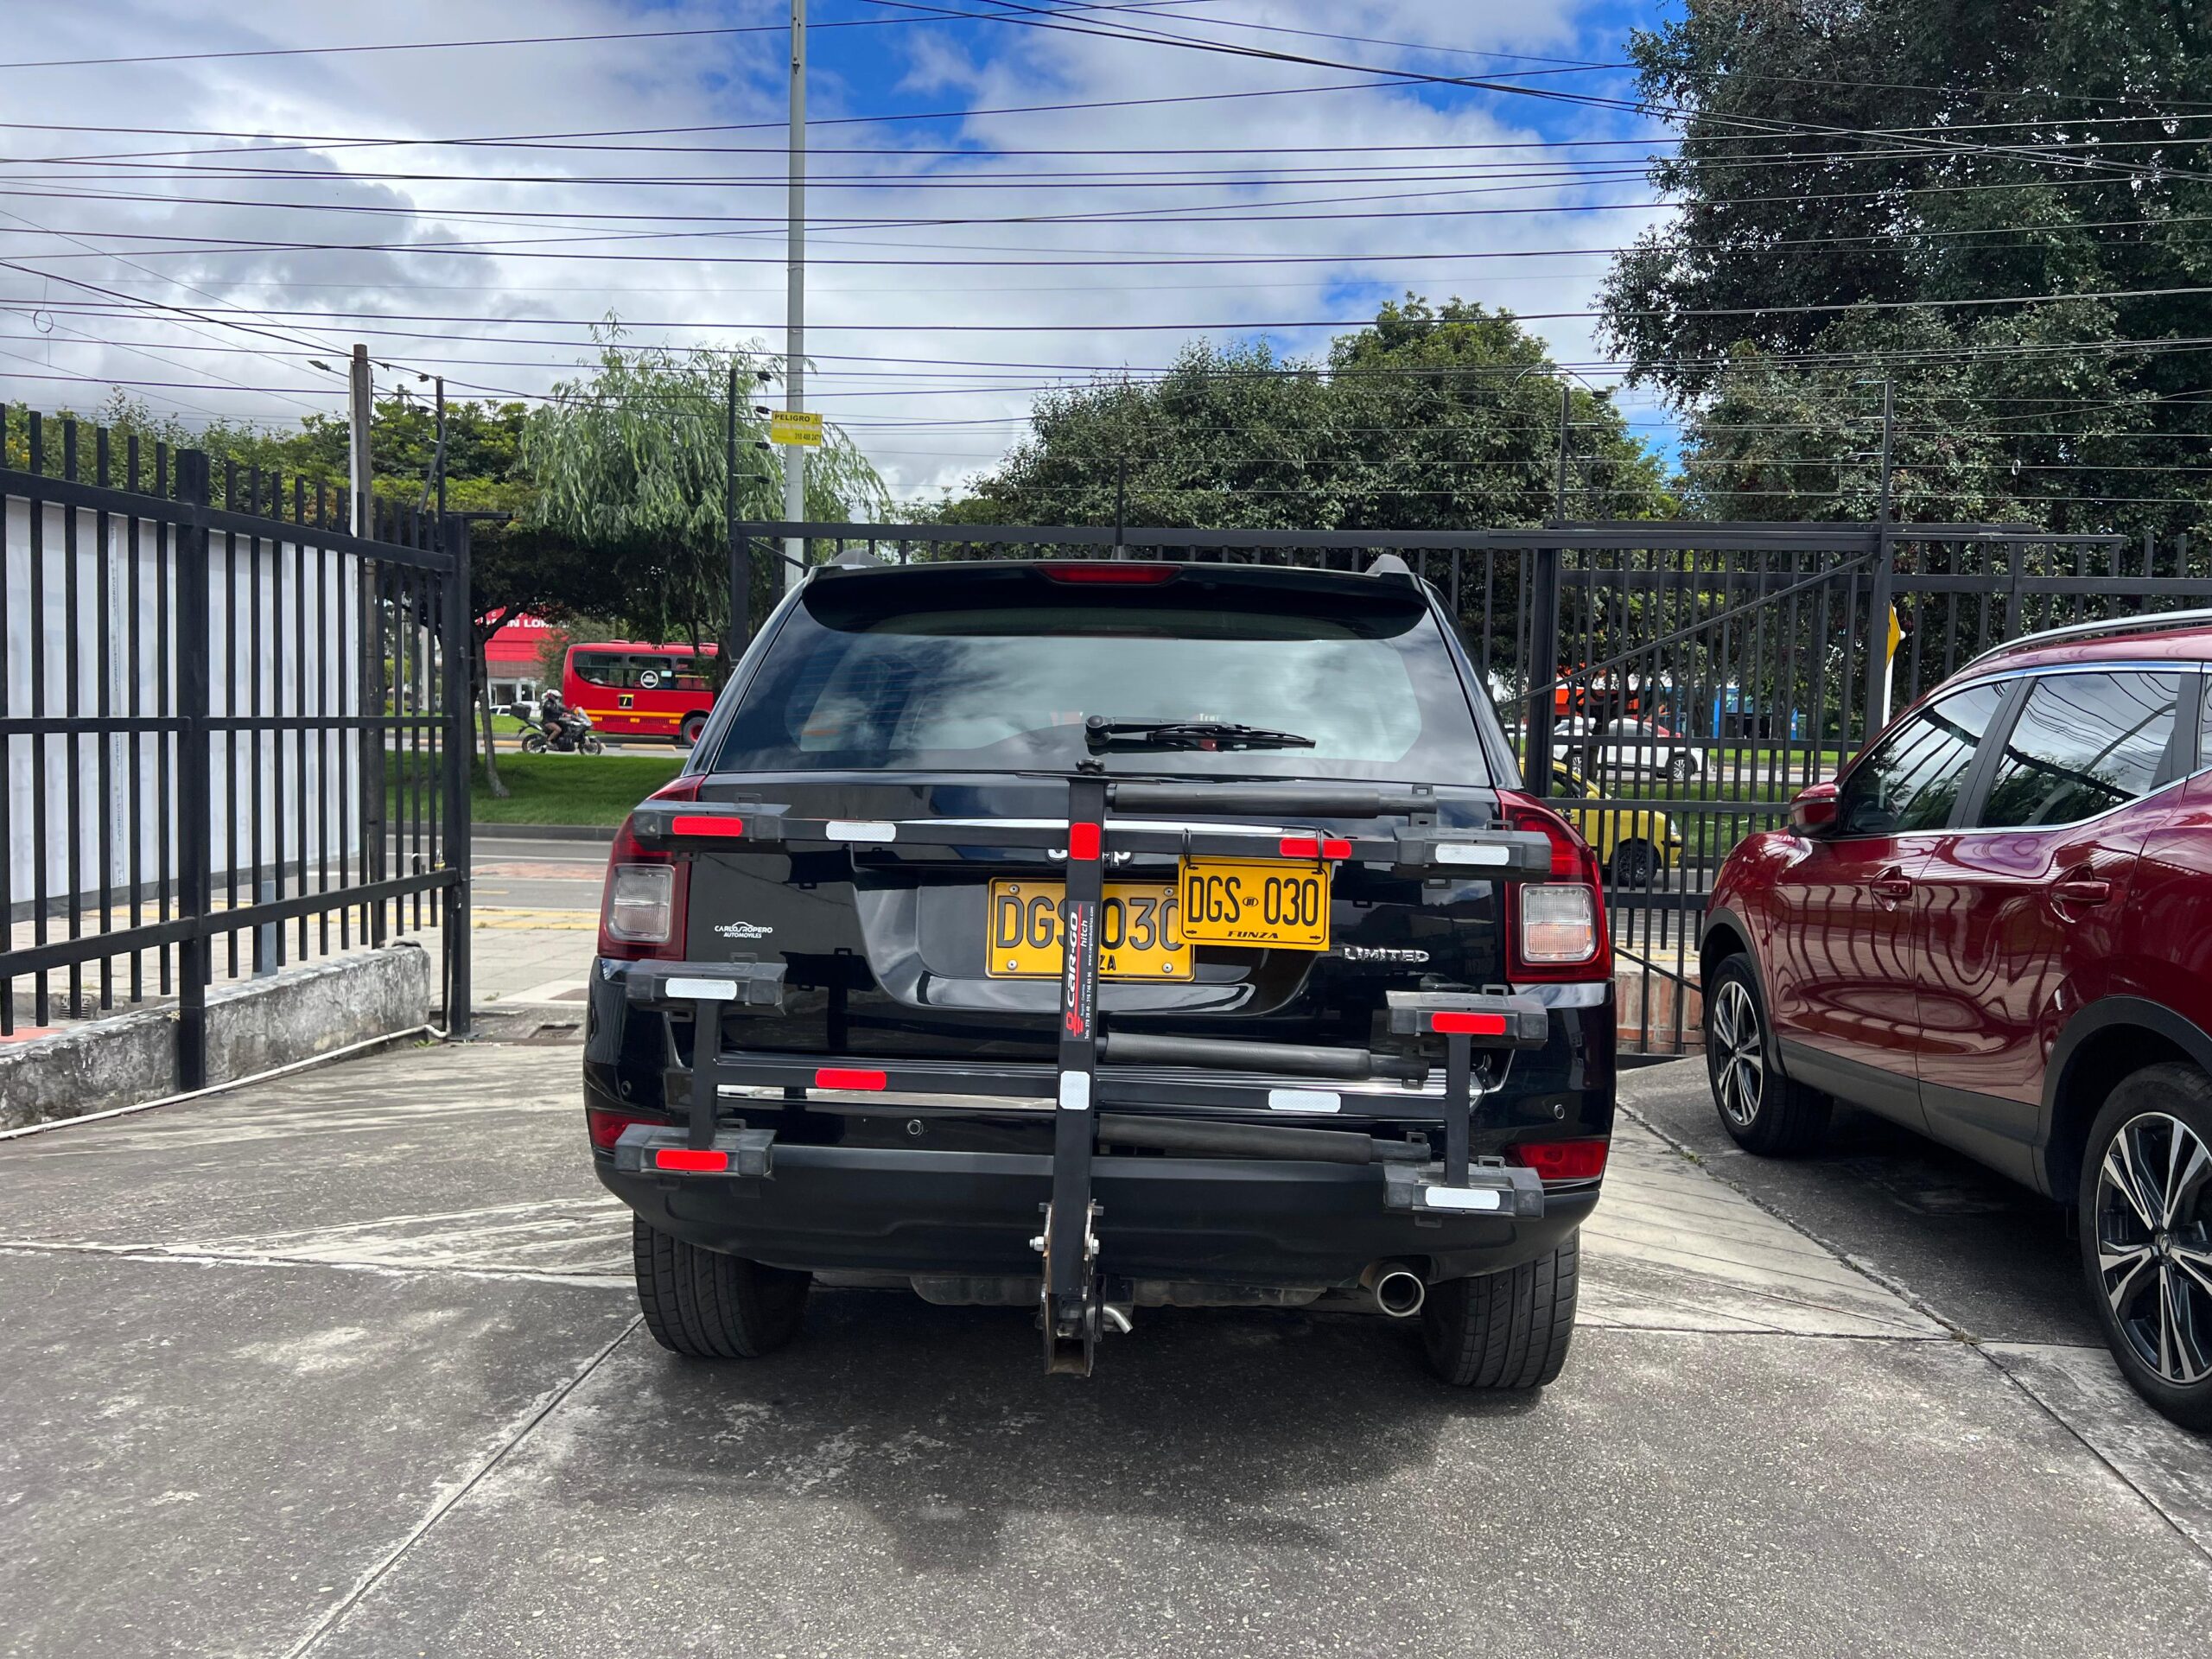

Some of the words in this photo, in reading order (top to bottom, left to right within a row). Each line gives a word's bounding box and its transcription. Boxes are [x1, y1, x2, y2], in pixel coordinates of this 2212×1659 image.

[774, 414, 810, 423] PELIGRO
[1188, 875, 1241, 923] DGS
[1264, 877, 1319, 926] 030
[1101, 897, 1184, 951] 030
[1227, 931, 1279, 939] FUNZA
[1344, 947, 1430, 963] LIMITED
